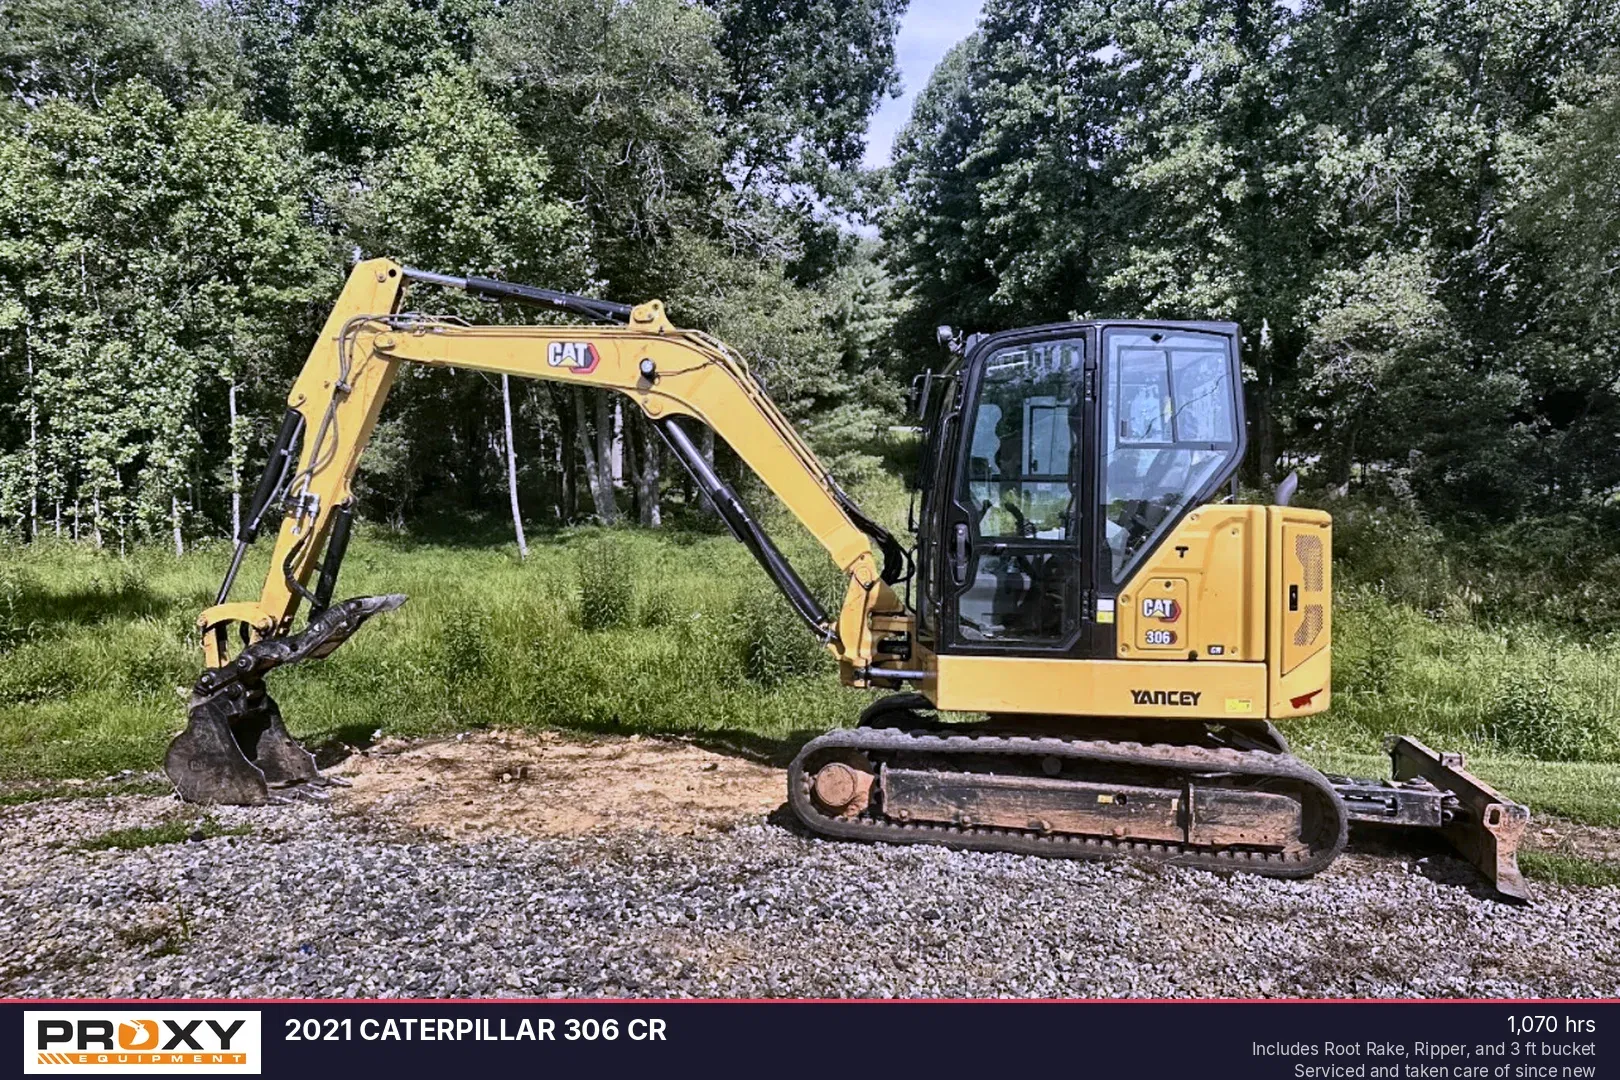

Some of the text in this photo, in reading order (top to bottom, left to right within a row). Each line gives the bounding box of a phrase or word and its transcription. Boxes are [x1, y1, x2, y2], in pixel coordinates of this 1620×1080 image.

[548, 341, 588, 367] CAT
[1143, 599, 1172, 617] CAT
[1146, 631, 1170, 644] 306
[1130, 690, 1202, 706] YANCEY
